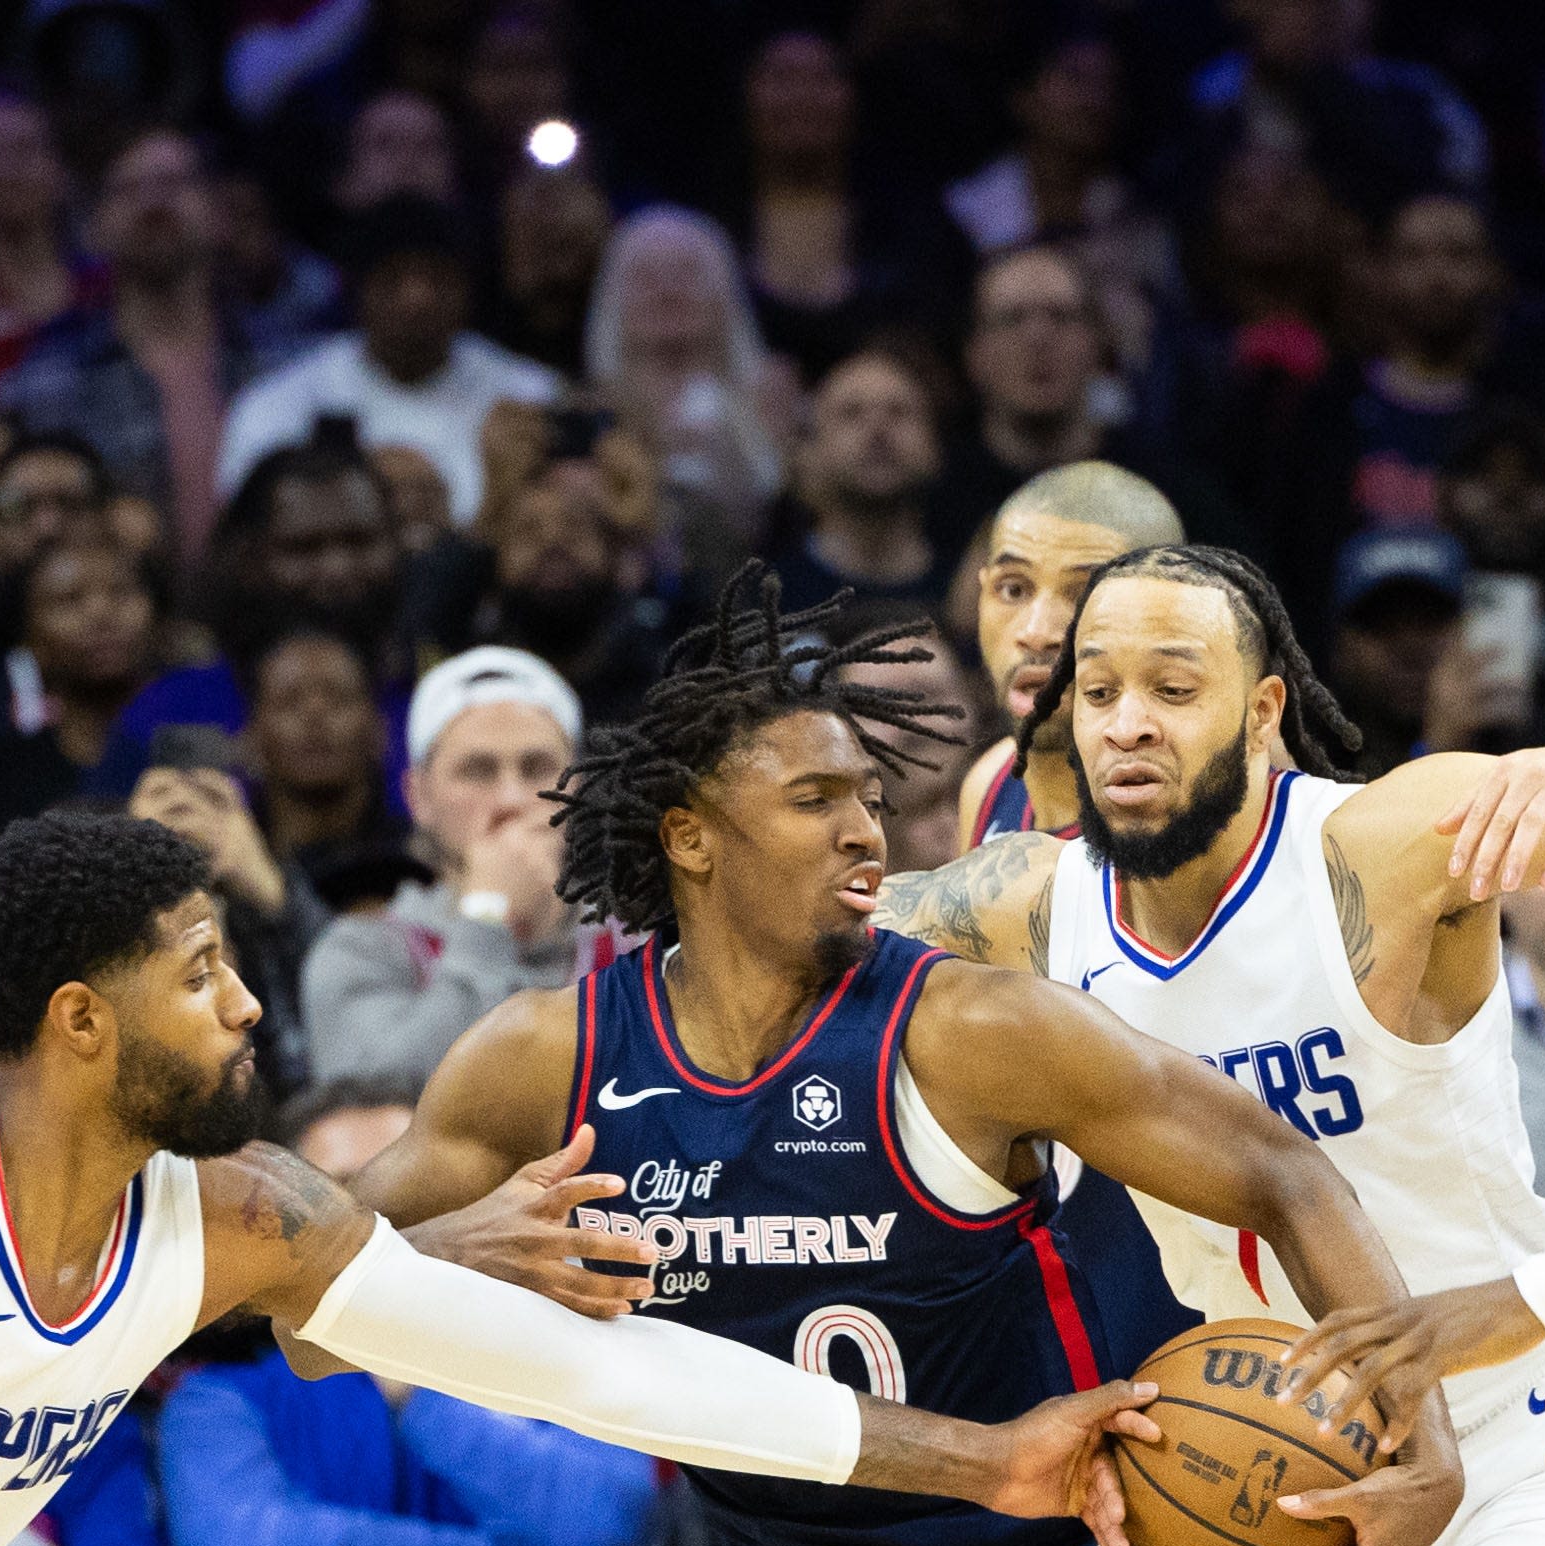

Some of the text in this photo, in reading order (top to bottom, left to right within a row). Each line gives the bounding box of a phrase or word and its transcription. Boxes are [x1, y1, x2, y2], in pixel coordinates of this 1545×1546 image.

[774, 1139, 866, 1153] crypto.com
[631, 1159, 722, 1219] City of
[639, 1252, 710, 1309] Love
